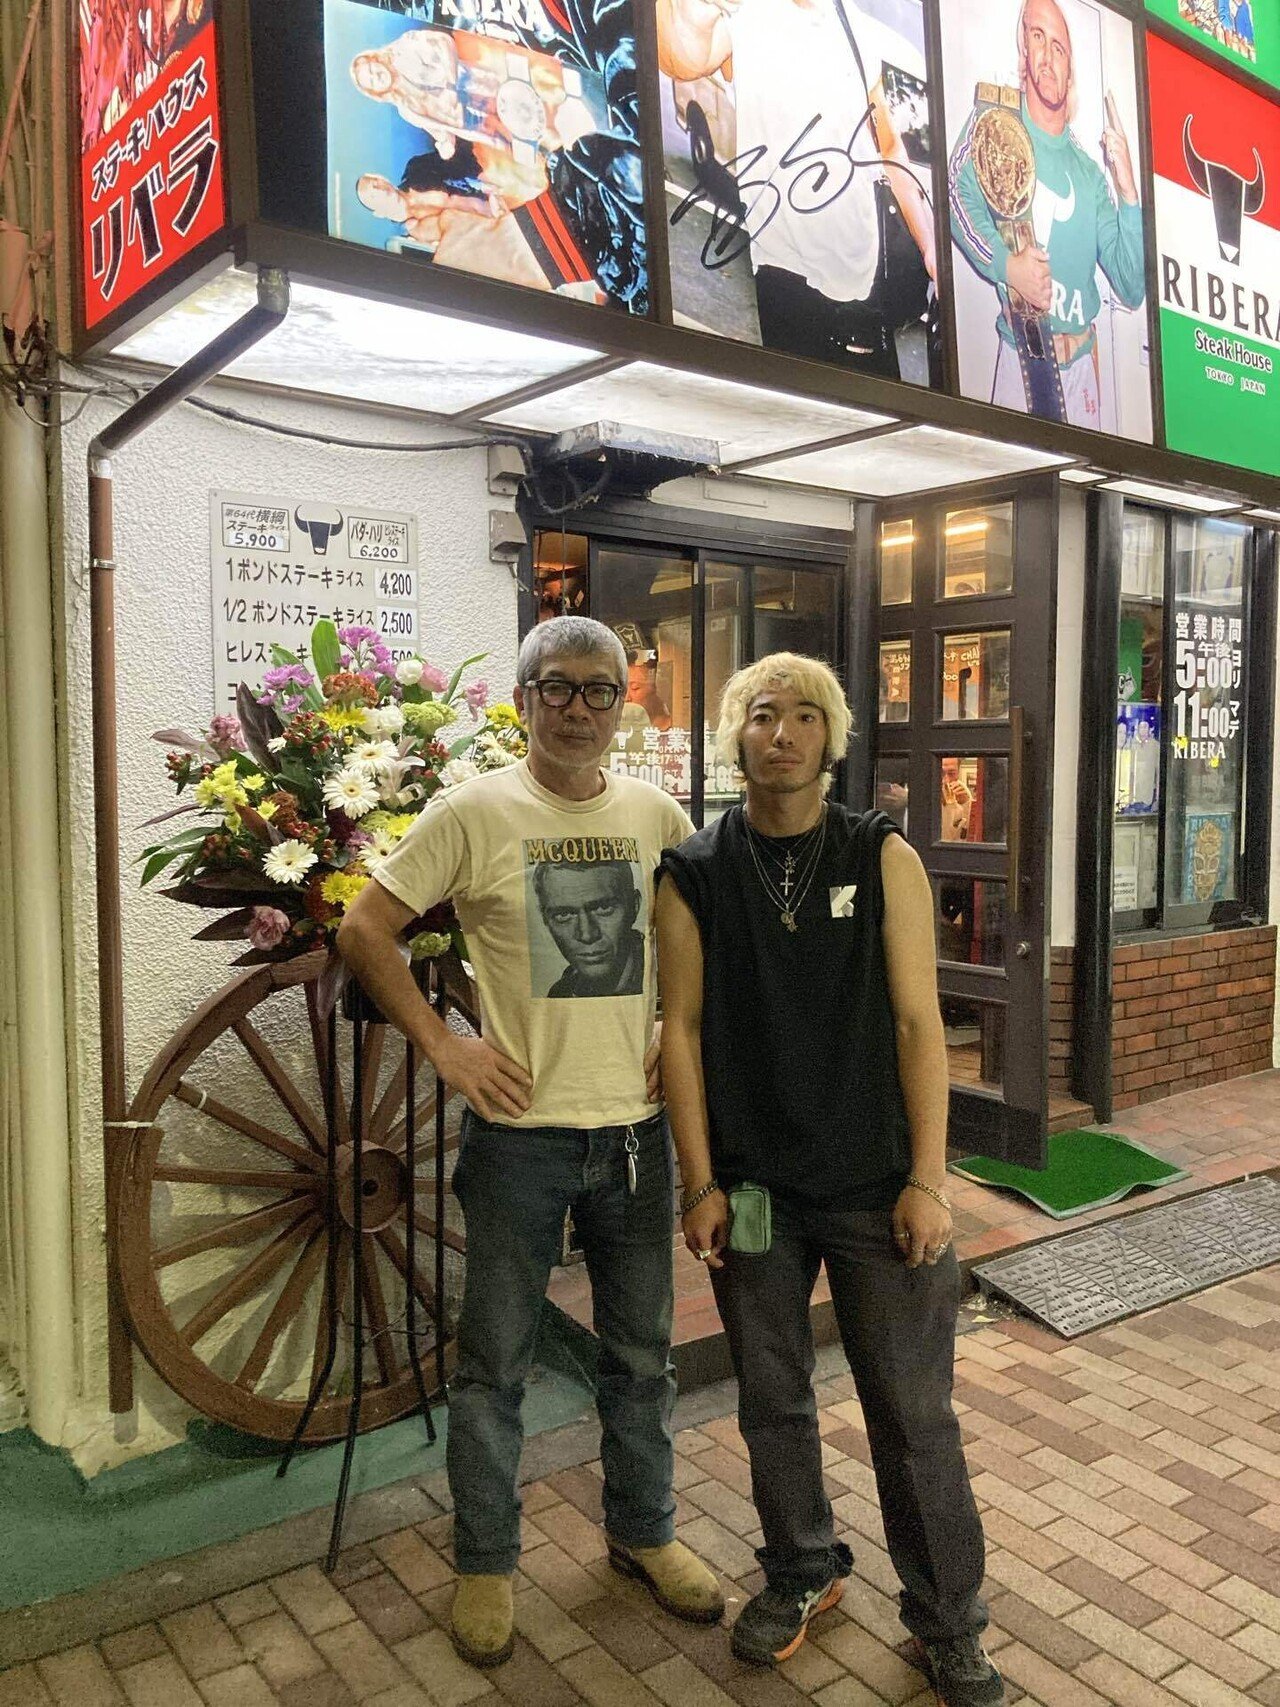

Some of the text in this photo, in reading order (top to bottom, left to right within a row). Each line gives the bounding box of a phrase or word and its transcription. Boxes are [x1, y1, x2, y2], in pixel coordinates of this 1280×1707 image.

[91, 55, 208, 202] ステーキハウス
[90, 115, 218, 301] リバラ
[1161, 253, 1280, 342] RIBER
[1194, 328, 1273, 373] Steak House
[1240, 377, 1266, 395] JAPAN
[379, 571, 412, 597] 4,200
[381, 610, 413, 637] 2,500
[1175, 612, 1243, 643] 営業時間
[1175, 640, 1233, 689] 5:00
[1198, 641, 1231, 658] 午後
[1232, 649, 1243, 690] ヨリ
[1173, 690, 1231, 739] 11:00
[1228, 700, 1240, 740] マデ
